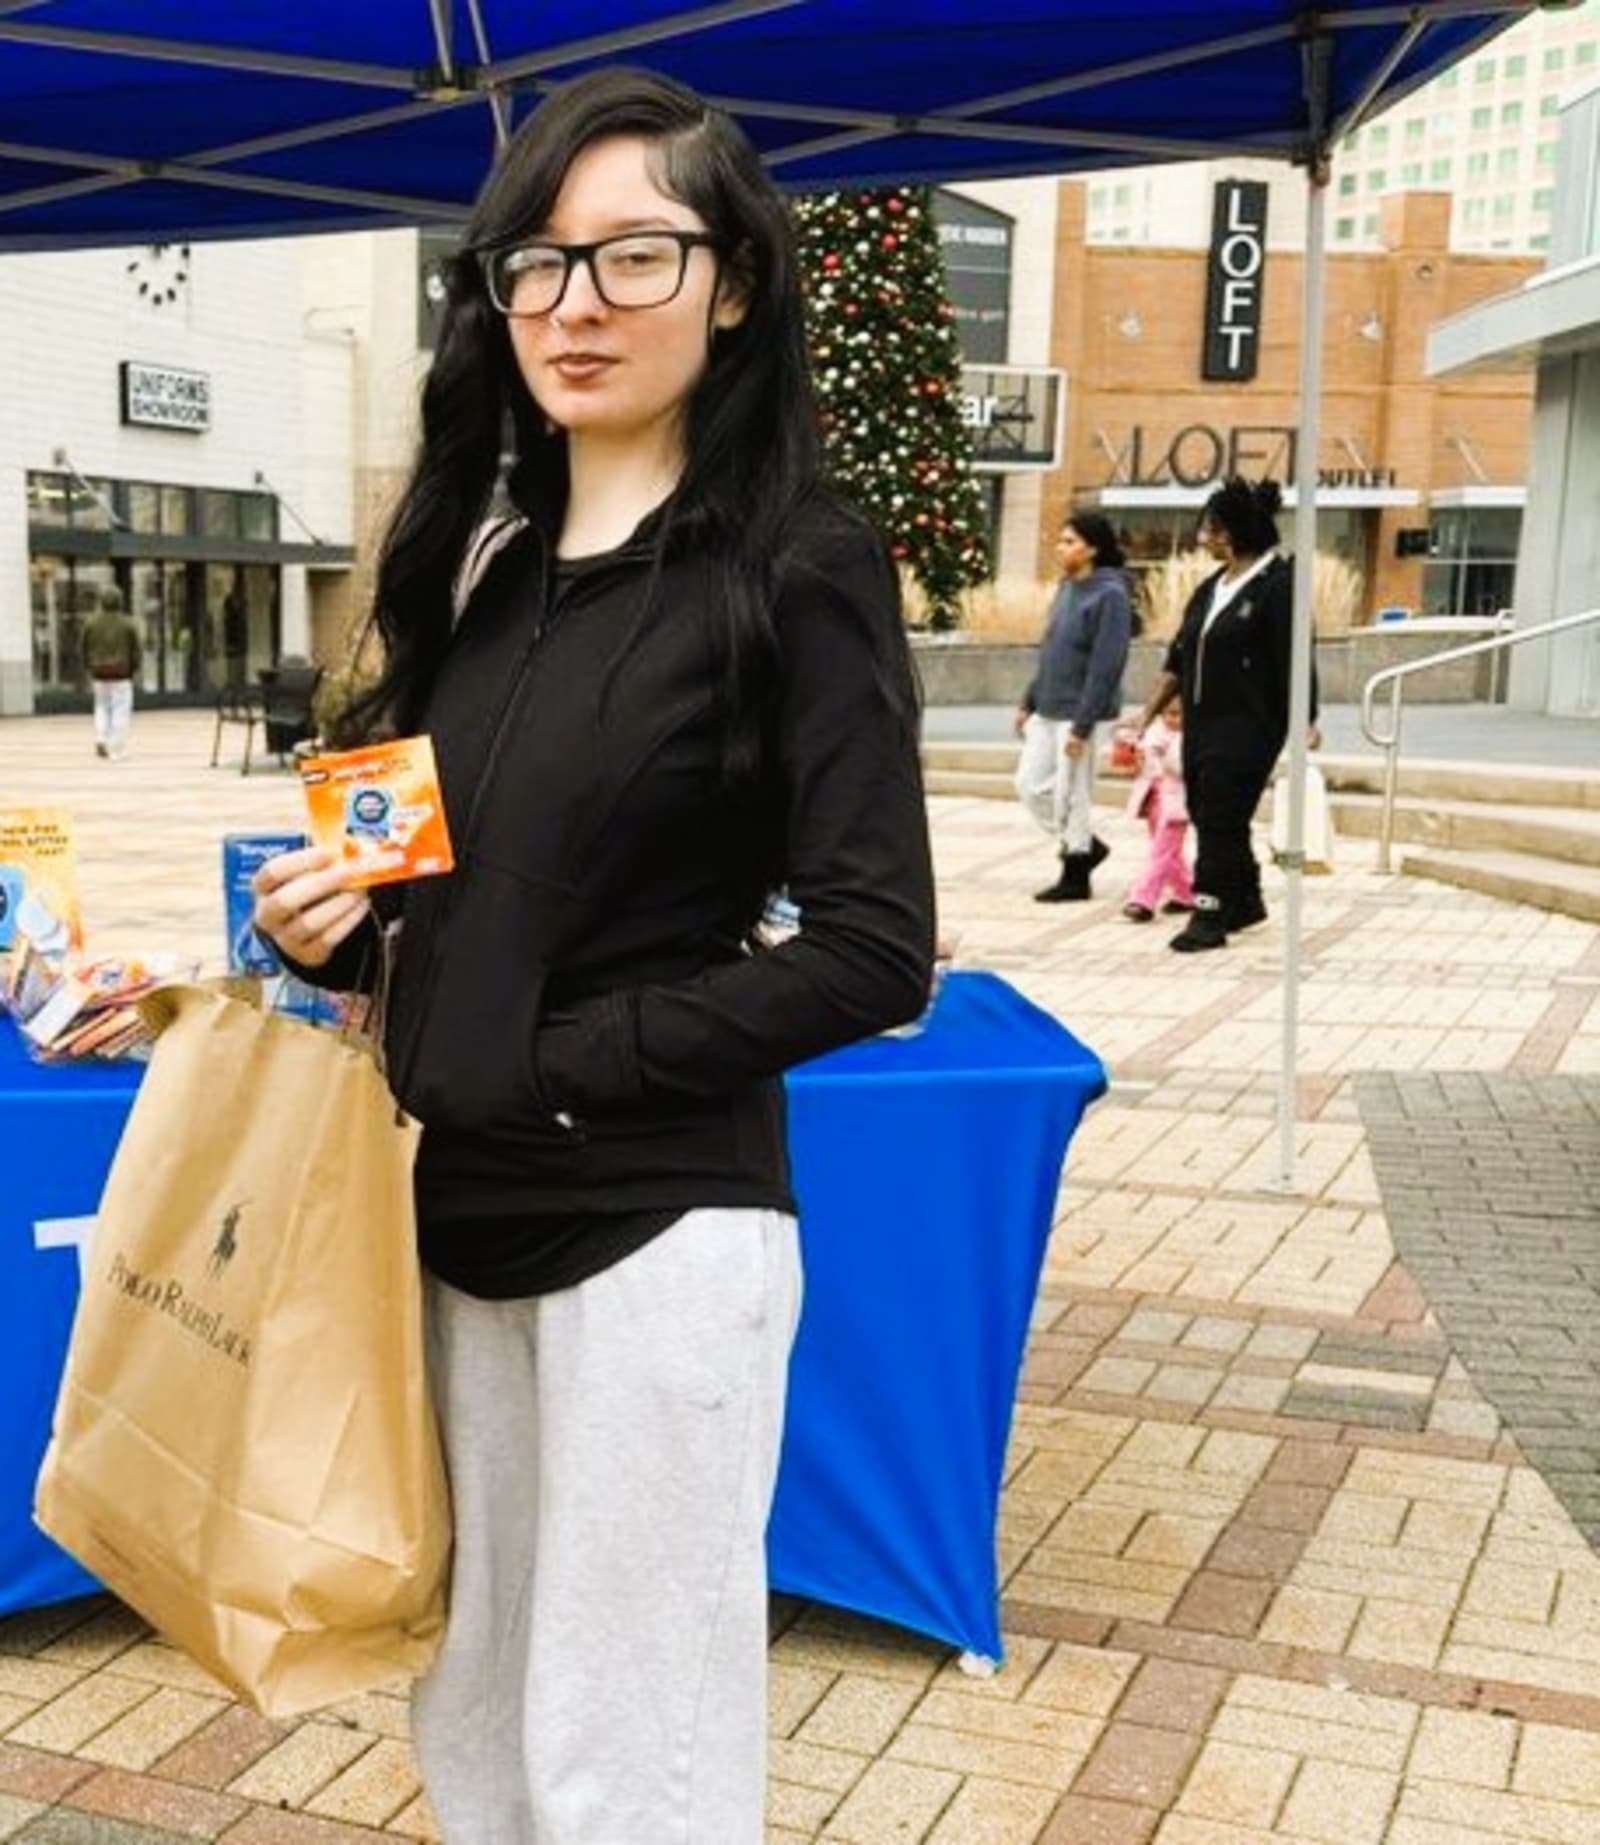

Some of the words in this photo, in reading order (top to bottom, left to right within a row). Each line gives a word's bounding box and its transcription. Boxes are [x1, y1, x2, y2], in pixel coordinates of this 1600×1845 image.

[1218, 188, 1262, 370] LOFT
[131, 369, 209, 404] UNIFORMS
[132, 398, 208, 424] SHOWROOM
[1129, 423, 1298, 488] LOFT
